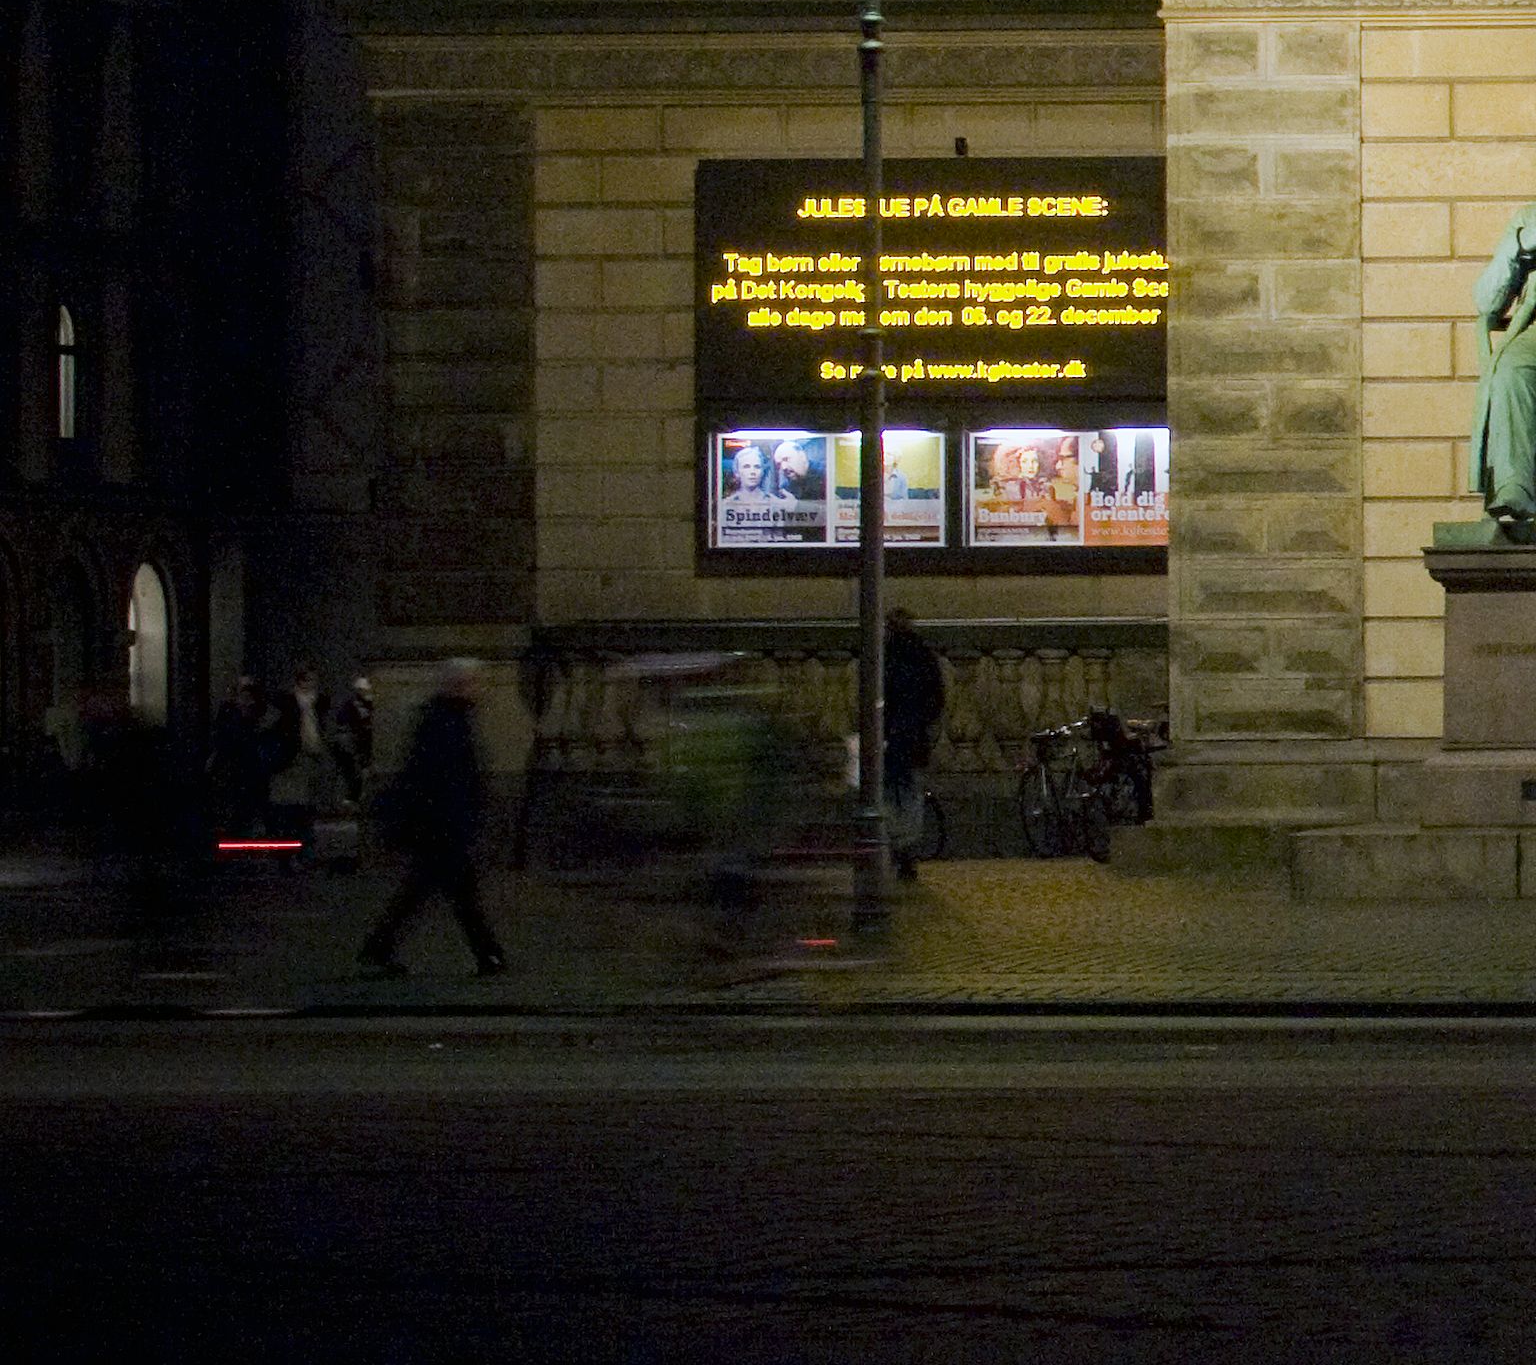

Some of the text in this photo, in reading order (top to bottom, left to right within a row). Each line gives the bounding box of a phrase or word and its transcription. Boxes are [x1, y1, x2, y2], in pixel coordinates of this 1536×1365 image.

[797, 193, 1110, 218] JULESUE PÅ GAMLE SCENE:
[722, 252, 763, 276] Tag
[766, 251, 814, 272] børn
[817, 251, 862, 272] eller
[879, 251, 970, 272] ørnebørn
[974, 251, 1018, 271] med
[711, 278, 738, 303] på
[741, 280, 776, 300] Det
[883, 279, 960, 299] Teaters
[963, 278, 1062, 302] hyggelige
[1065, 278, 1129, 298] Gamle
[747, 307, 783, 327] alle
[785, 307, 836, 330] dage
[913, 307, 953, 326] den
[996, 308, 1024, 330] og
[1025, 305, 1057, 325] 22.
[1060, 305, 1162, 325] december
[819, 360, 847, 380] Se
[900, 357, 925, 383] på
[1090, 488, 1165, 512] Hold dig
[725, 508, 819, 525] Spindelvæv
